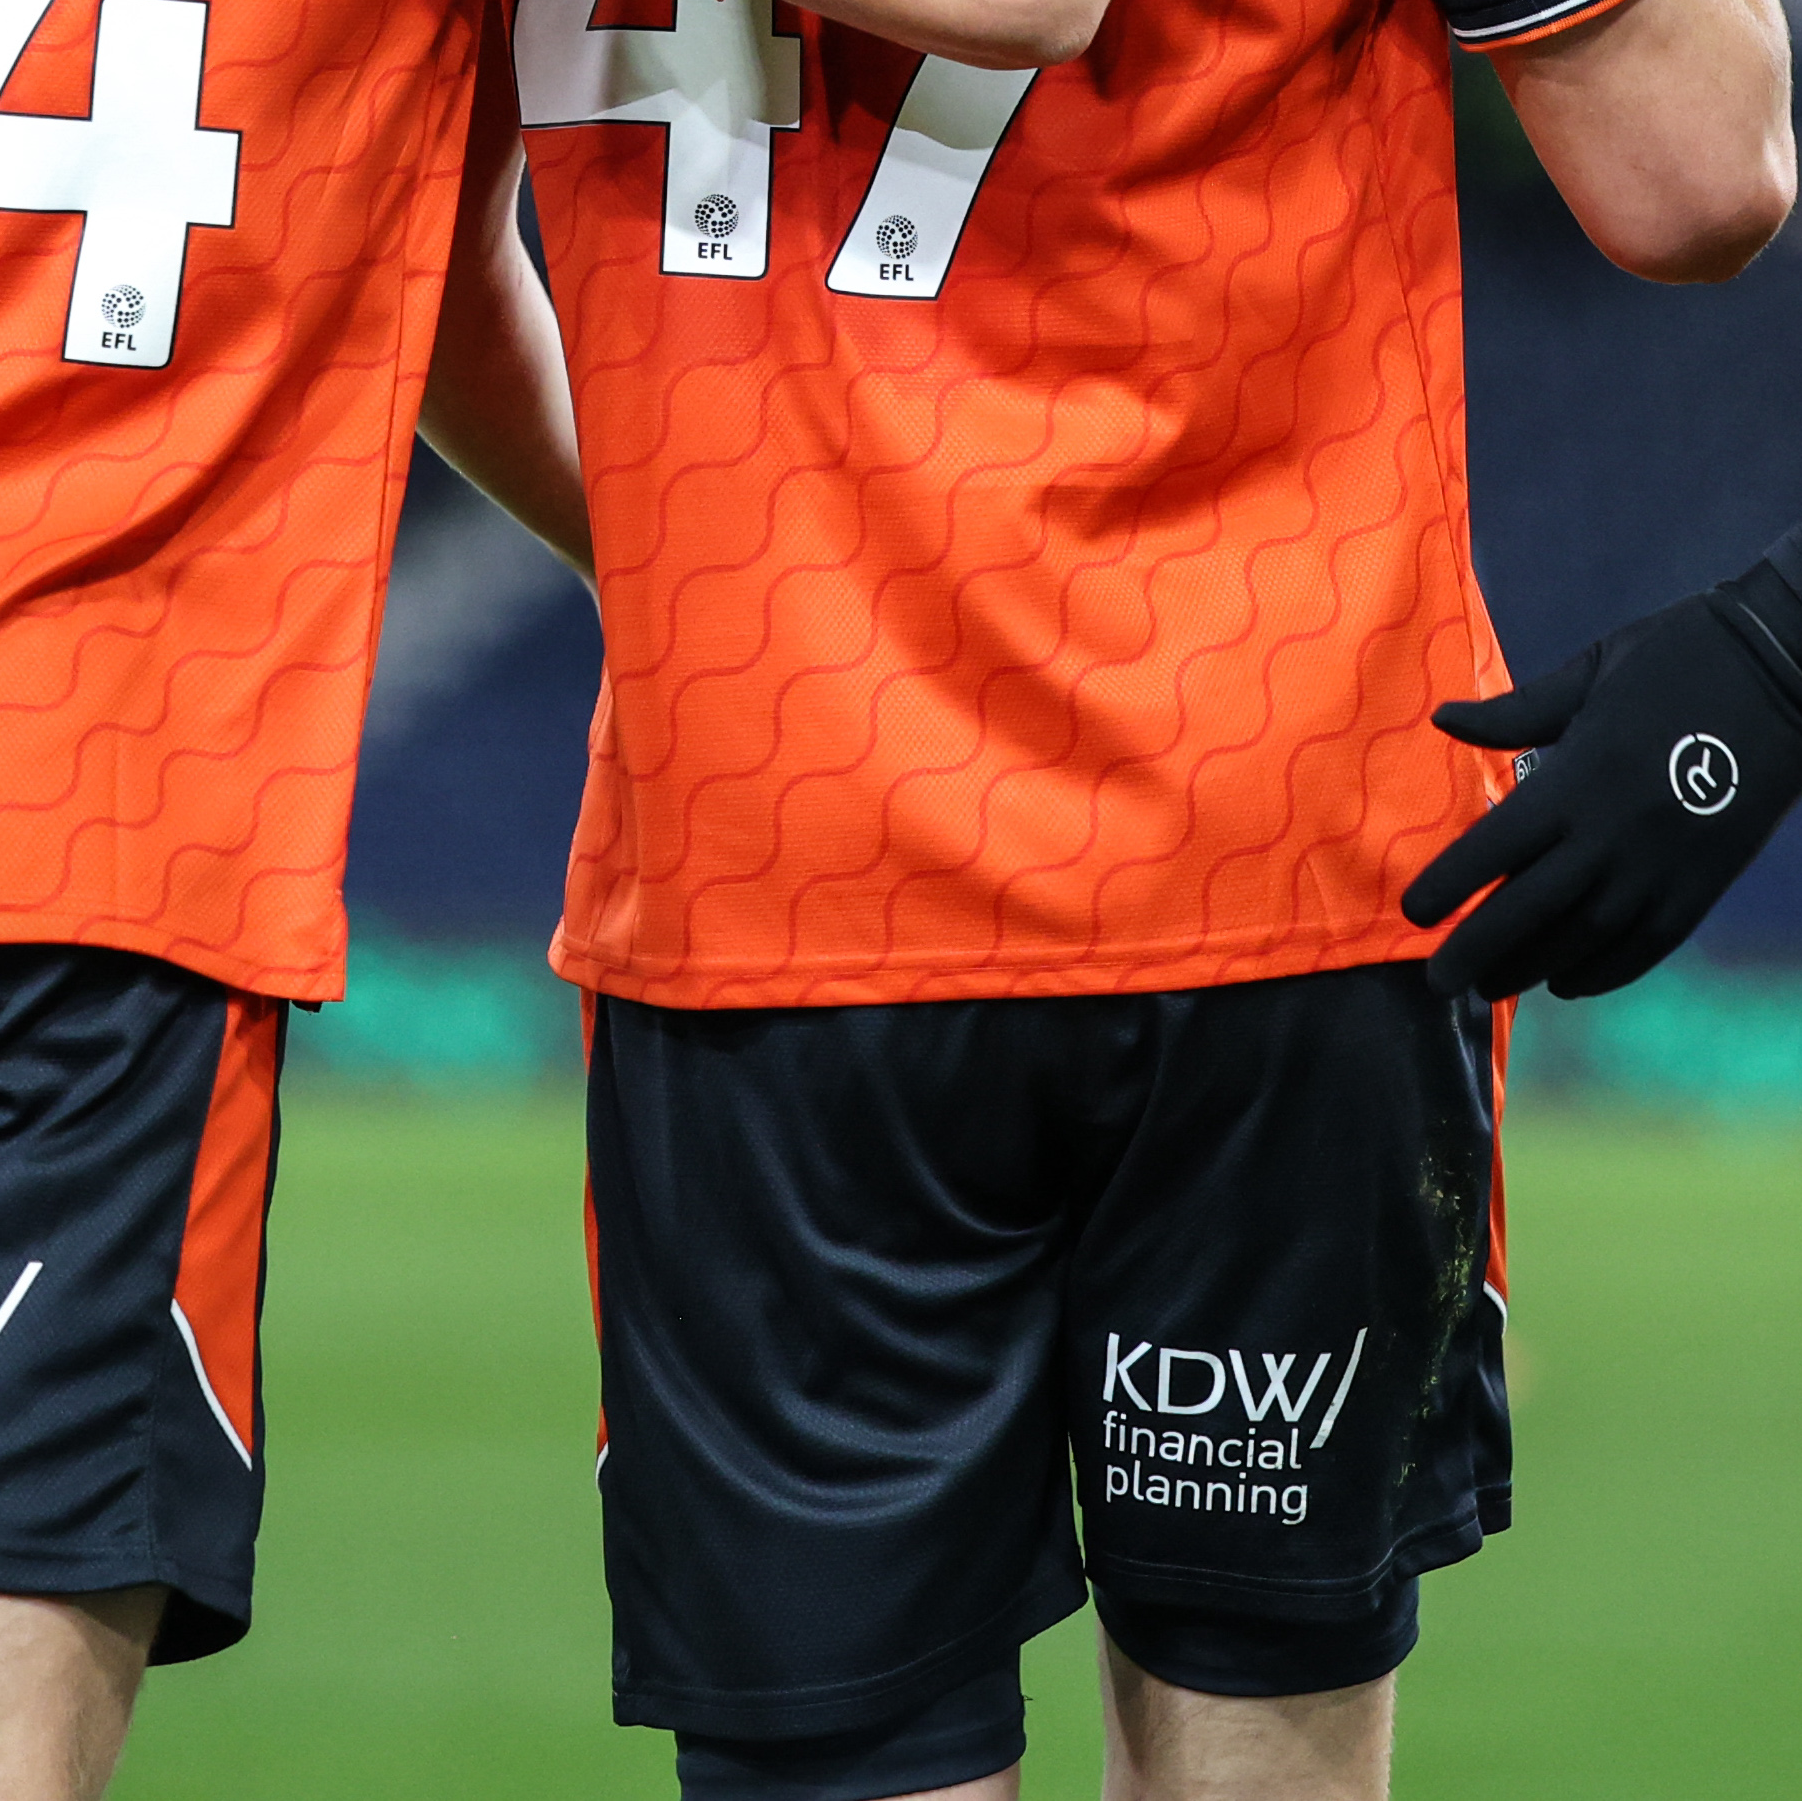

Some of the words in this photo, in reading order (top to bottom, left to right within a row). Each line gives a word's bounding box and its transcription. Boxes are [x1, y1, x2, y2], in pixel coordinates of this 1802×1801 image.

[697, 242, 733, 261] EFL
[879, 263, 914, 282] EFL
[101, 331, 137, 352] EFL
[1102, 1410, 1302, 1470] financial
[1105, 1459, 1309, 1526] planning
